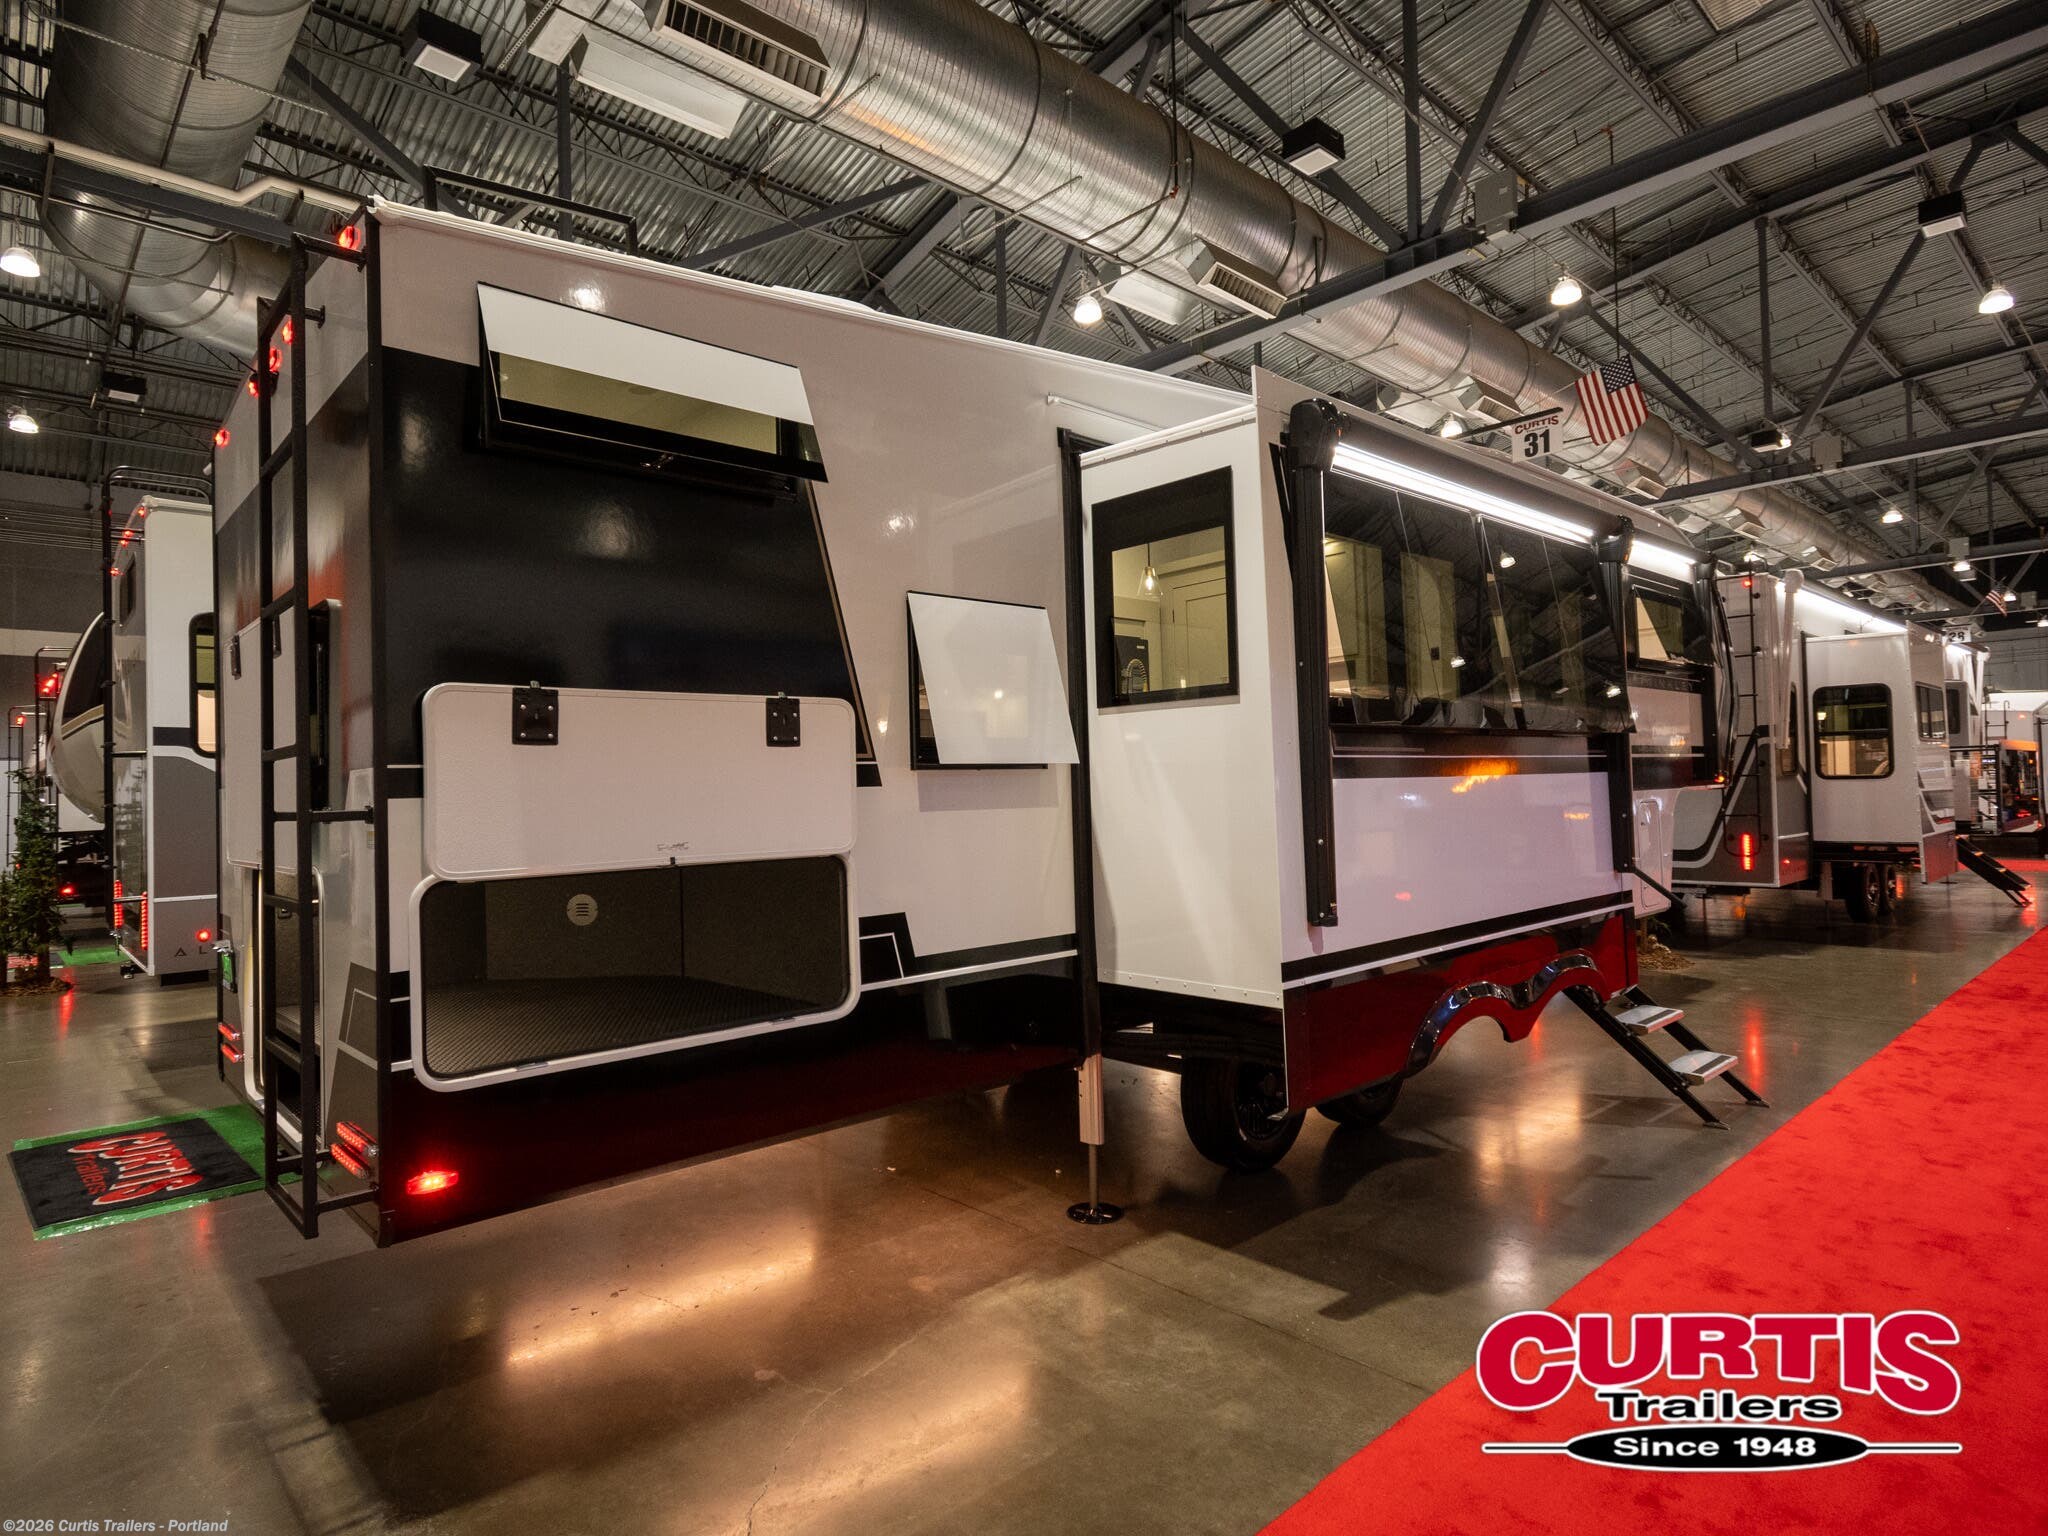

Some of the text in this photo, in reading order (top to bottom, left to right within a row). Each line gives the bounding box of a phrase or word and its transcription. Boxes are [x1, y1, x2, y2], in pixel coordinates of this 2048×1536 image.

[1514, 415, 1559, 434] CURTIS
[1524, 429, 1550, 457] 31
[67, 1132, 203, 1205] CURTIS
